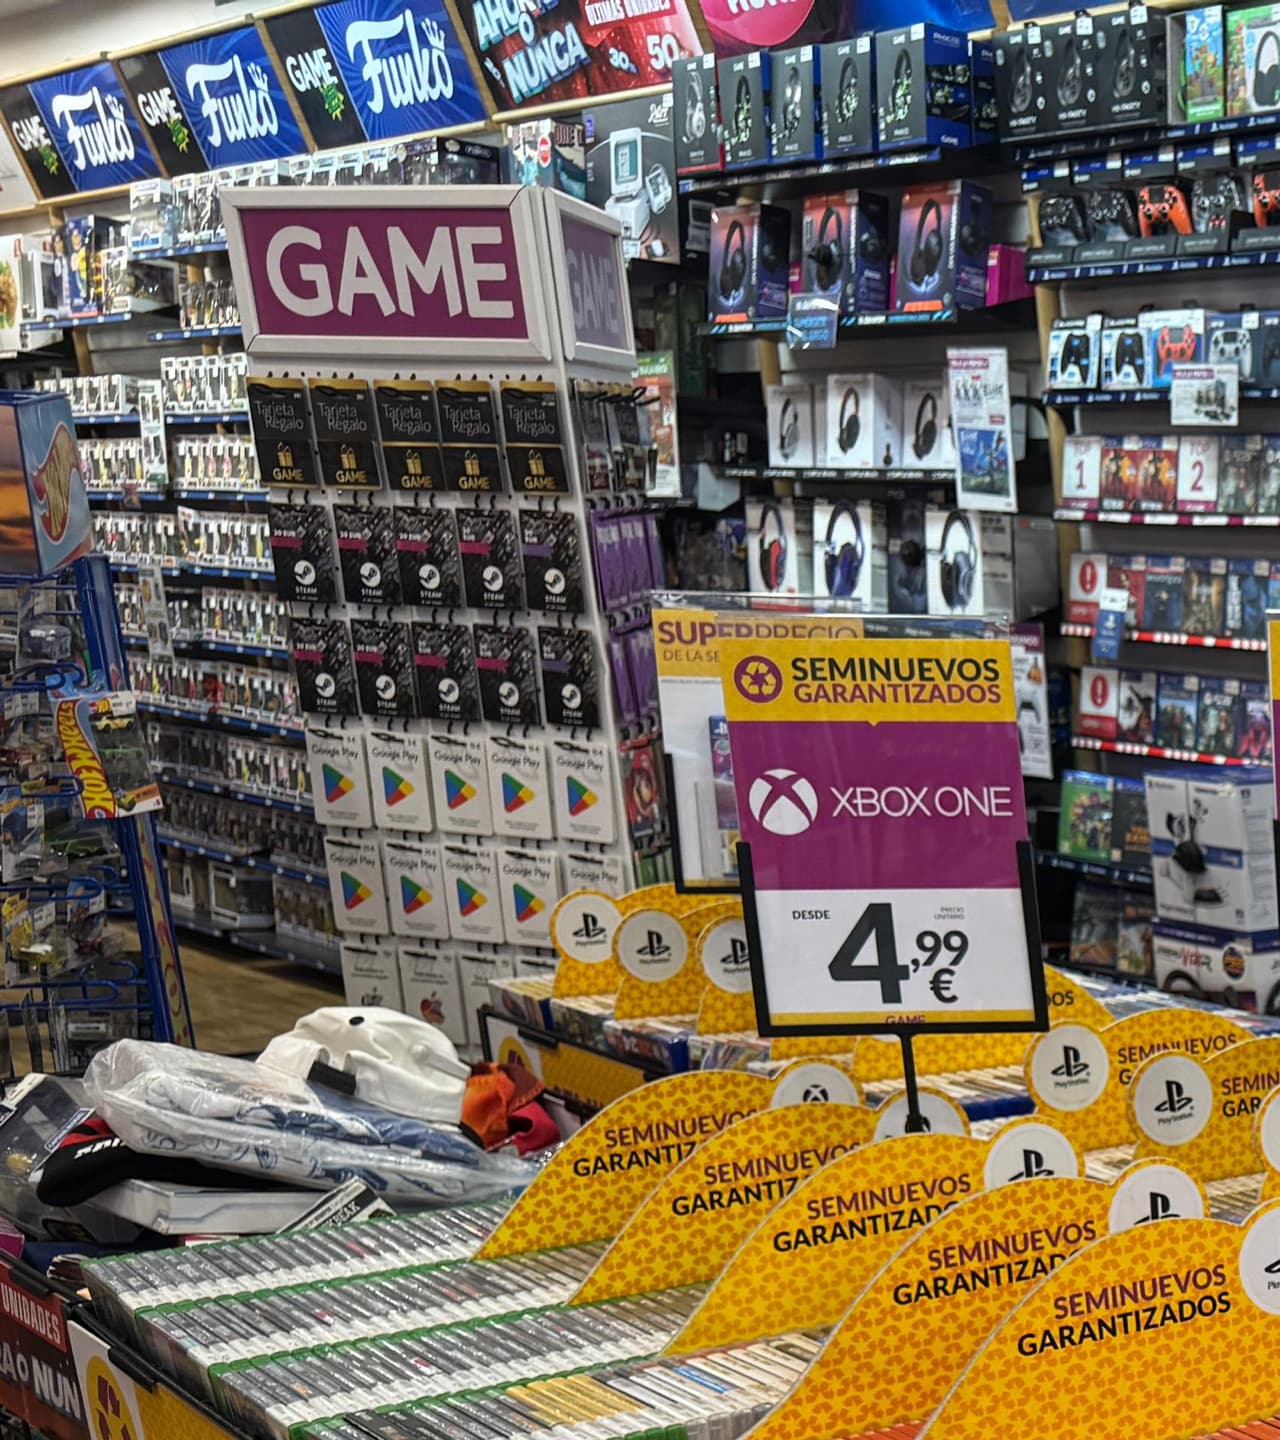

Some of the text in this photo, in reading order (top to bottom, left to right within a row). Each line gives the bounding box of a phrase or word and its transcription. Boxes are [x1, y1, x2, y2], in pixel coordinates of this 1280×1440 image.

[286, 18, 454, 123] GAME Funko
[504, 22, 587, 100] NUNCA
[138, 56, 278, 147] GAME Funko
[12, 91, 136, 170] GAME Funko
[267, 226, 514, 318] GAME
[564, 247, 620, 351] GAME
[317, 403, 357, 421] Tarjeta
[328, 418, 367, 432] Regalo
[336, 470, 367, 483] GAME
[792, 658, 999, 682] SEMINUEVOS
[794, 684, 1001, 704] GARANTIZADOS
[830, 786, 1013, 817] XBOX ONE
[792, 909, 830, 920] DESDE
[1054, 1264, 1226, 1320] SEMINUEVOS
[1017, 1290, 1231, 1357] GARANTIZADOS
